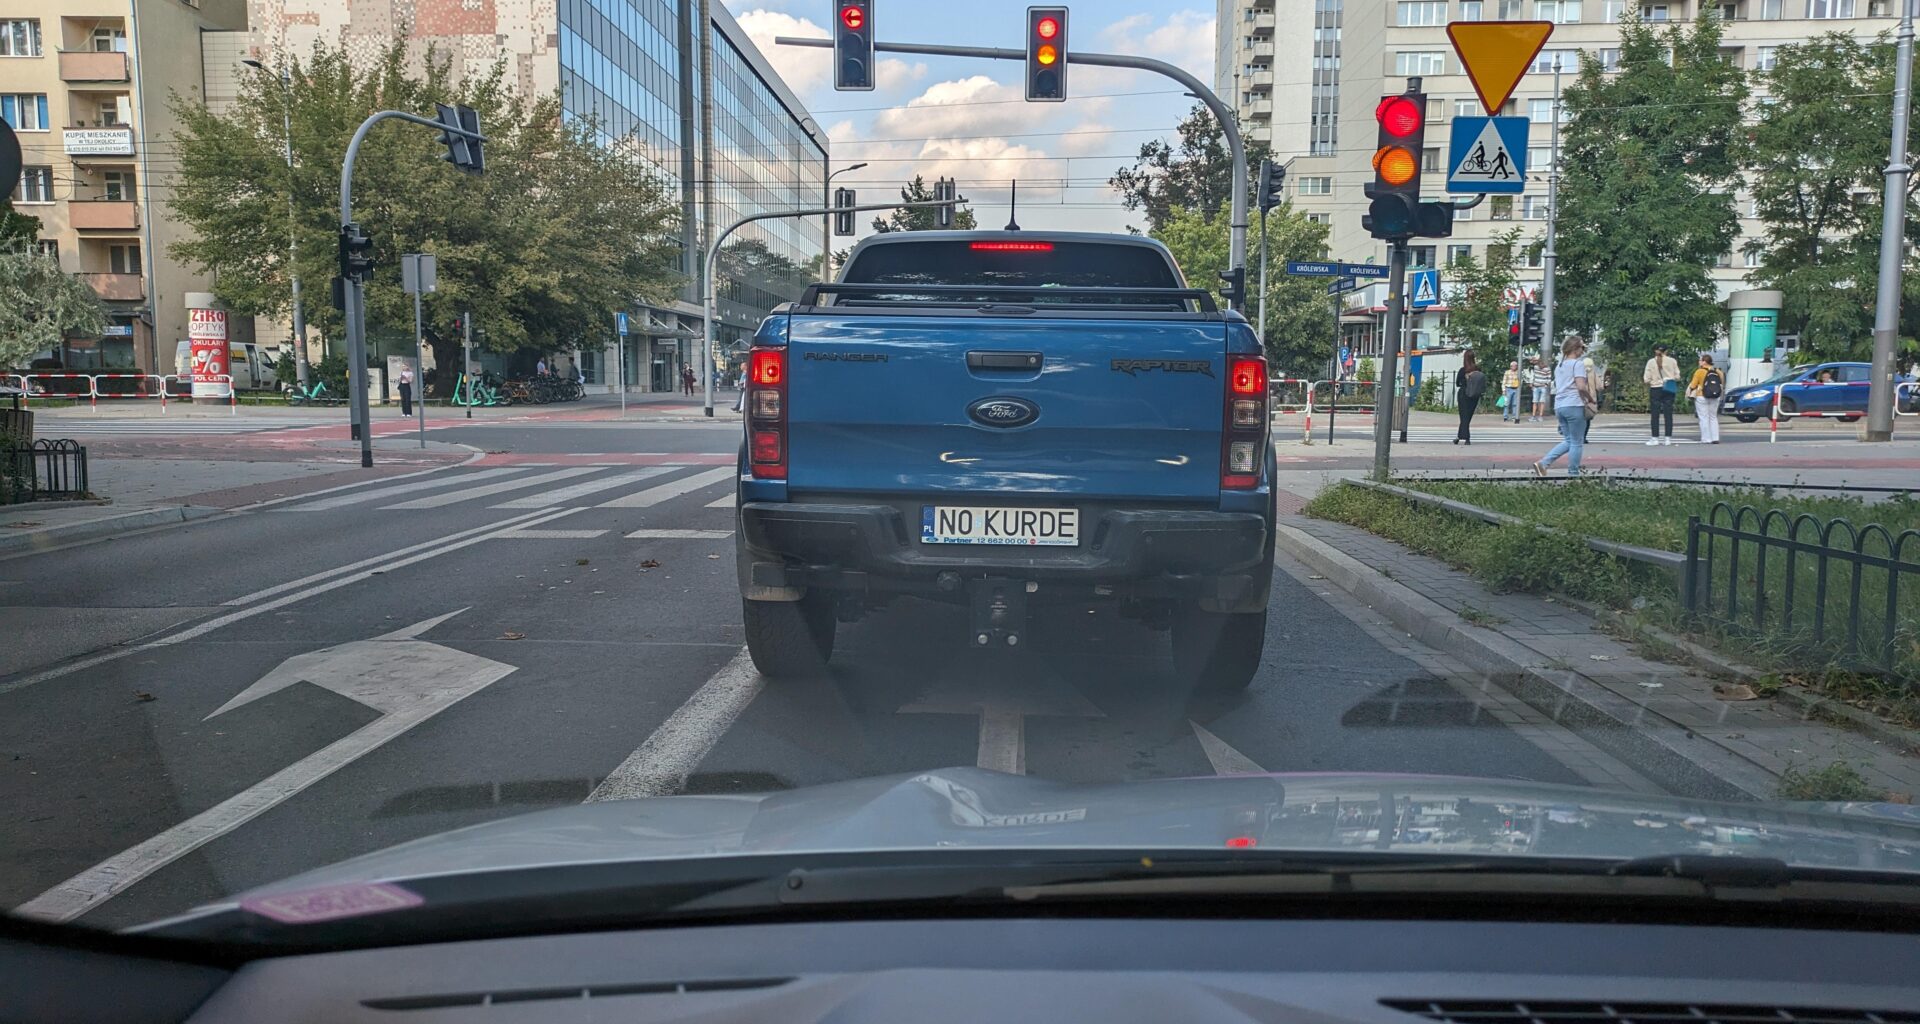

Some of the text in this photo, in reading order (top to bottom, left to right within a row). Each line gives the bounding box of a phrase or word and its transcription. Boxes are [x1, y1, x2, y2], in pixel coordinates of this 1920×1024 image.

[1296, 265, 1329, 273] KRÓLEWSKA
[1350, 266, 1380, 275] KRÓLEWSKA
[191, 323, 224, 331] OPTYK
[802, 351, 889, 362] RANGER
[1110, 358, 1216, 378] RAPTOR
[988, 404, 1018, 418] Ford
[984, 509, 1075, 538] KURDE
[923, 525, 934, 533] PL
